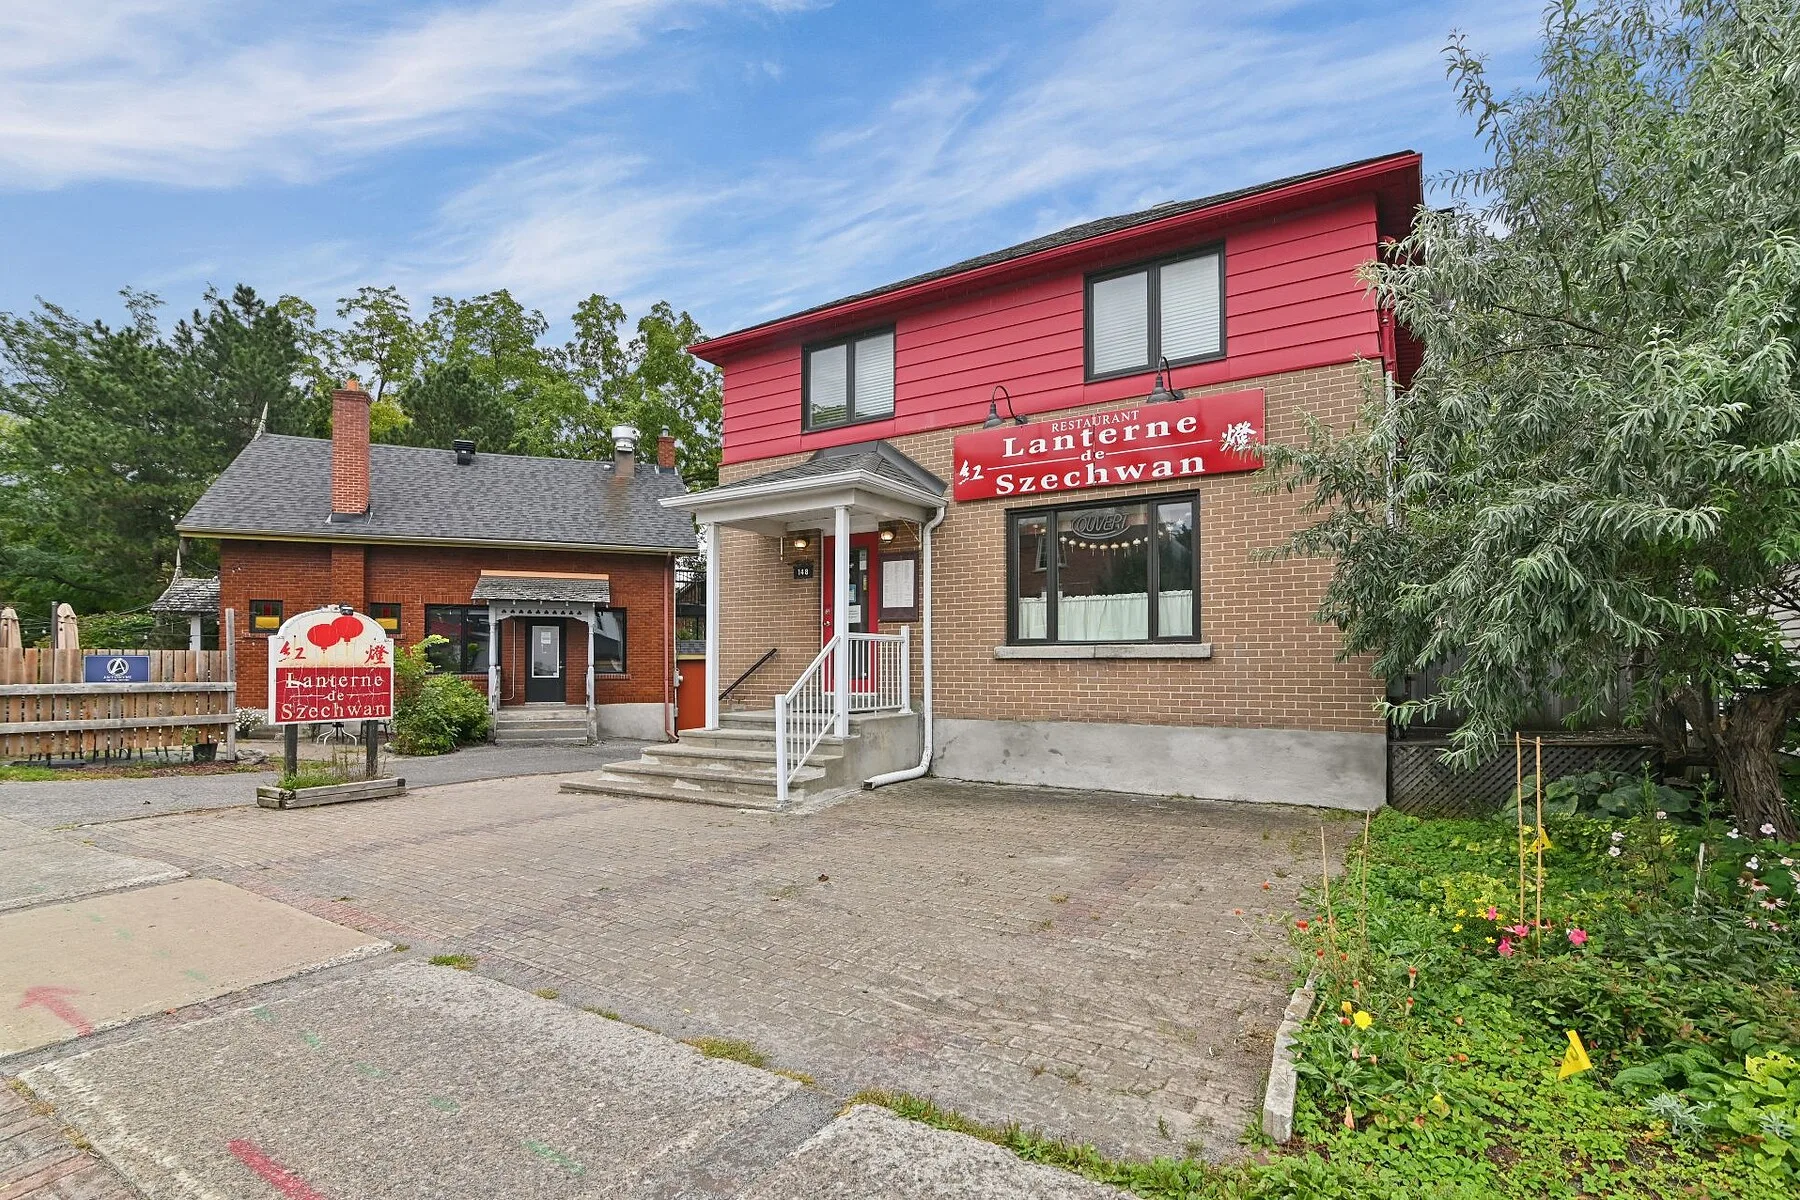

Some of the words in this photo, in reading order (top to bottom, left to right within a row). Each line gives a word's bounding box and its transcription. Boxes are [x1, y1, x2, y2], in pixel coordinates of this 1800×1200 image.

[1051, 409, 1140, 433] RESTAURANT
[1002, 415, 1197, 458] Lanterne
[1080, 449, 1105, 461] de
[995, 455, 1206, 495] Szechwan
[1076, 512, 1130, 533] OUVERT
[797, 568, 809, 576] 148
[285, 672, 384, 689] Lanterne
[327, 690, 345, 701] de
[281, 702, 386, 720] Szechwan
